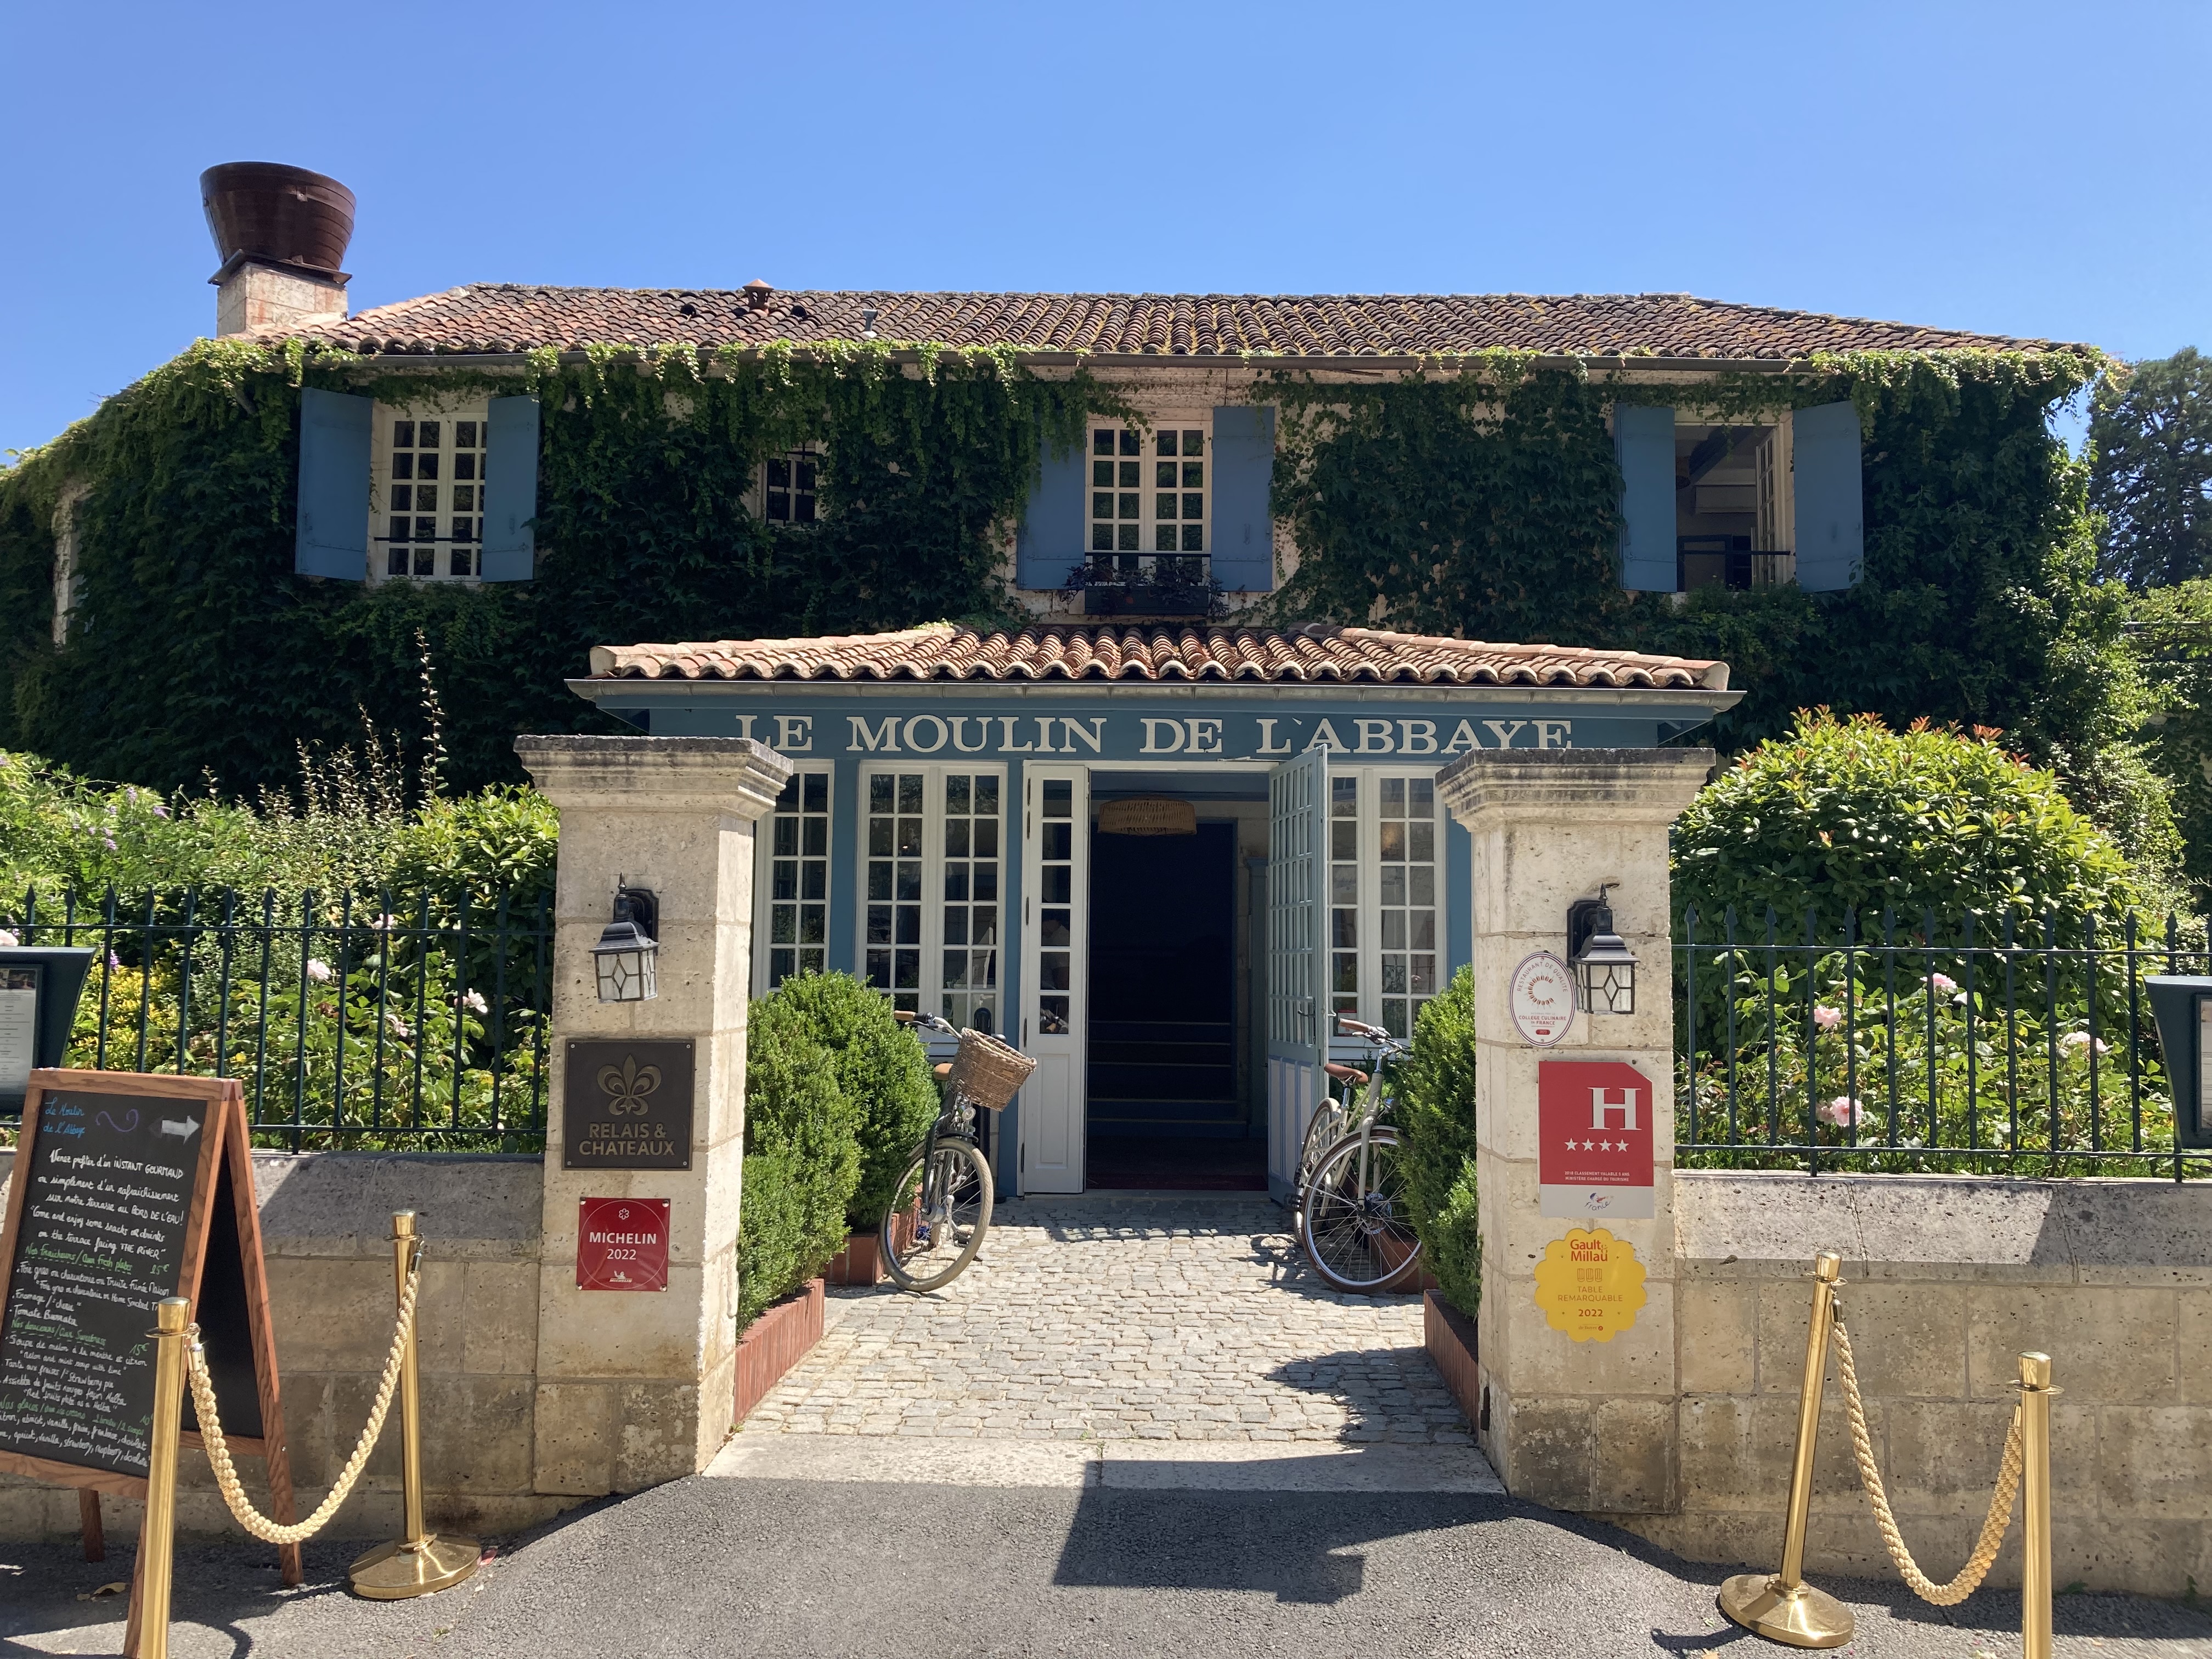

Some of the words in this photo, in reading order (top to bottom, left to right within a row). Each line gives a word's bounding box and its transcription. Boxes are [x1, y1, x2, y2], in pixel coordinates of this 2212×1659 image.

[736, 715, 812, 751] LE
[846, 715, 1107, 753] MOULIN
[1139, 718, 1223, 753] DE
[1517, 961, 1543, 992] RESTAURANT
[45, 1097, 57, 1115] Le
[1587, 1087, 1642, 1131] H
[43, 1122, 53, 1132] de
[589, 1123, 650, 1139] RELAIS
[654, 1122, 667, 1138] &
[579, 1140, 675, 1156] CHATEAUX
[49, 1148, 71, 1163] Venez
[145, 1164, 184, 1180] GOURMAND
[50, 1175, 94, 1190] simplement
[45, 1194, 63, 1203] sur
[64, 1194, 84, 1206] notre
[86, 1197, 115, 1211] terrasse
[117, 1206, 128, 1214] au
[131, 1205, 148, 1219] BORD
[150, 1210, 160, 1220] DE
[52, 1211, 65, 1222] and
[66, 1214, 84, 1228] enjoy
[86, 1218, 103, 1228] some
[104, 1222, 128, 1236] snacks
[139, 1228, 165, 1242] drinks
[50, 1229, 64, 1240] the
[65, 1232, 92, 1245] terrace
[94, 1237, 117, 1254] facing
[120, 1243, 134, 1253] THE
[589, 1232, 657, 1245] MICHELIN
[1570, 1239, 1601, 1250] Gault
[607, 1249, 636, 1260] 2022
[1571, 1250, 1608, 1261] Millau
